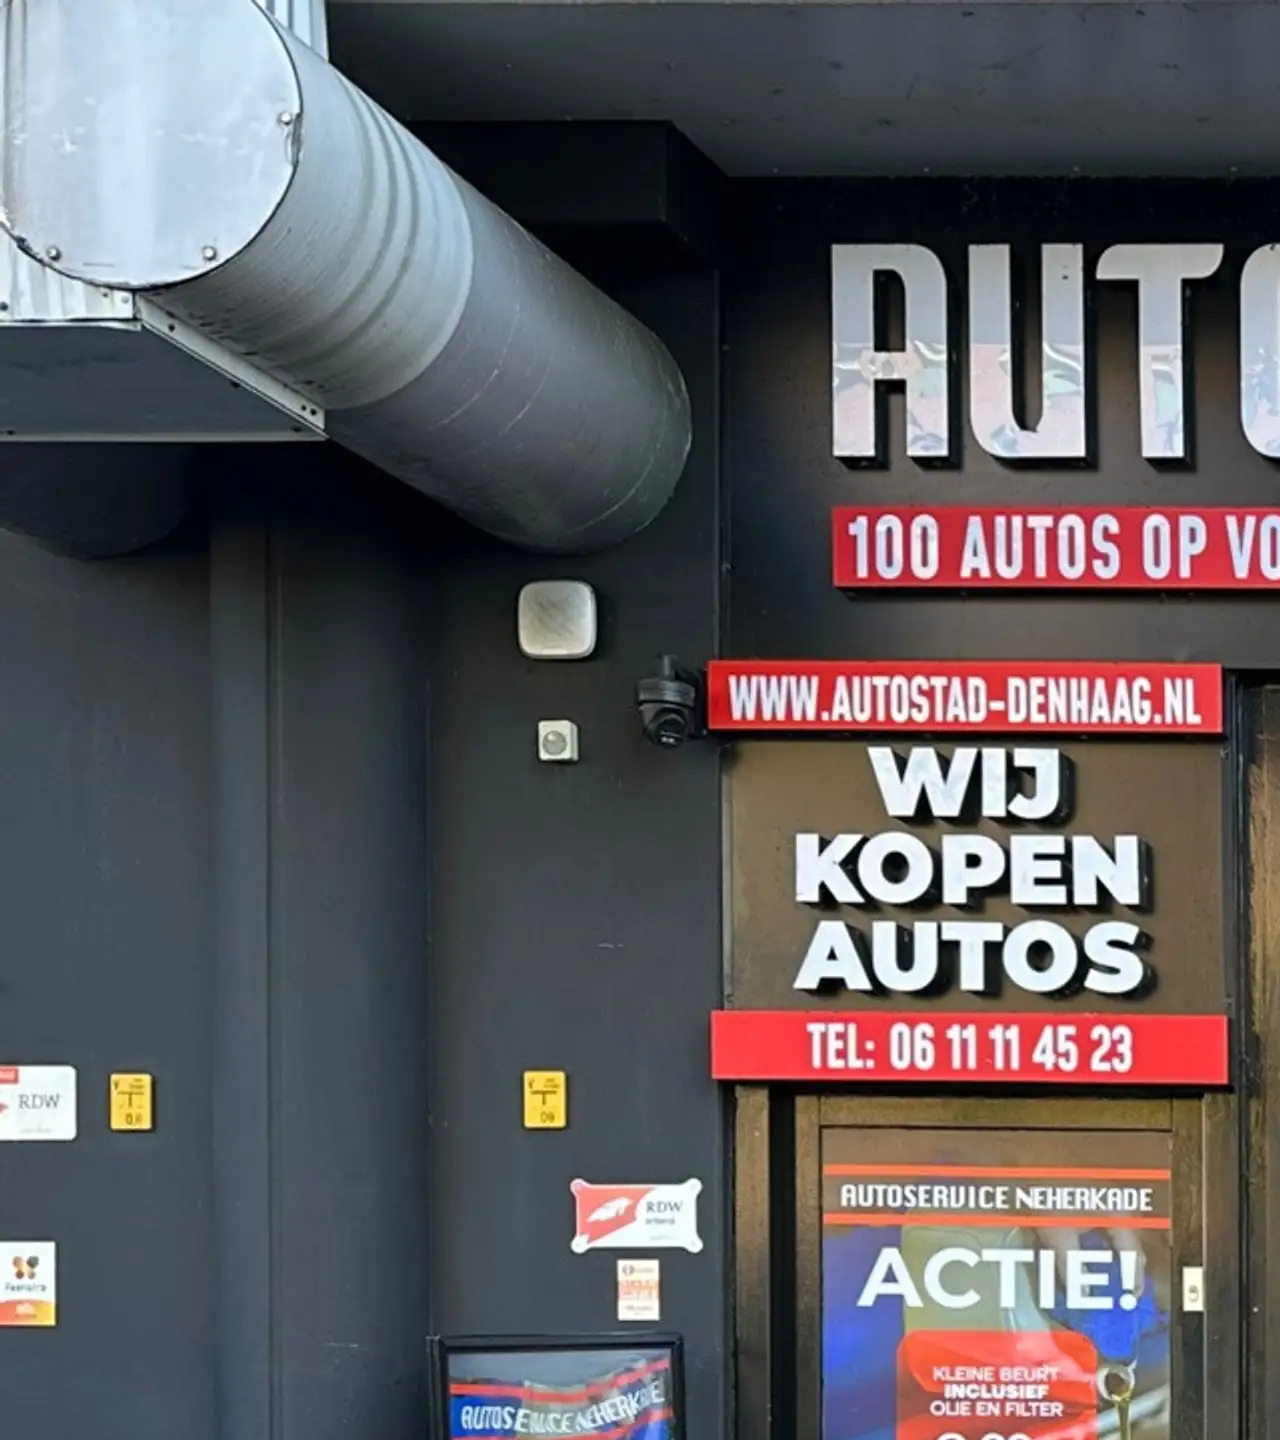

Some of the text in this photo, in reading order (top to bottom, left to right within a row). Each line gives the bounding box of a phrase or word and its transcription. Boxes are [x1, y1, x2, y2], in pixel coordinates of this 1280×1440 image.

[849, 515, 938, 579] 100
[961, 514, 1119, 579] AUTOS
[1143, 514, 1206, 579] OP
[729, 675, 1202, 724] WWW.AUTOSTAD-DENHAAG.NL
[868, 746, 1060, 819] WIJ
[795, 832, 1142, 905] KOPEN
[793, 920, 1145, 993] AUTOS
[807, 1022, 1133, 1072] TEL: 06 11 11 45 23
[18, 1093, 61, 1109] RDW
[646, 1200, 683, 1213] RDW
[841, 1184, 1152, 1212] AUTOSERVICE NEHERKADE
[857, 1247, 1138, 1310] ACTIE!
[933, 1365, 1060, 1381] KLEINE BEURT
[944, 1384, 1049, 1399] INCLUSIEF
[930, 1400, 1064, 1417] OLIE EN FILTER
